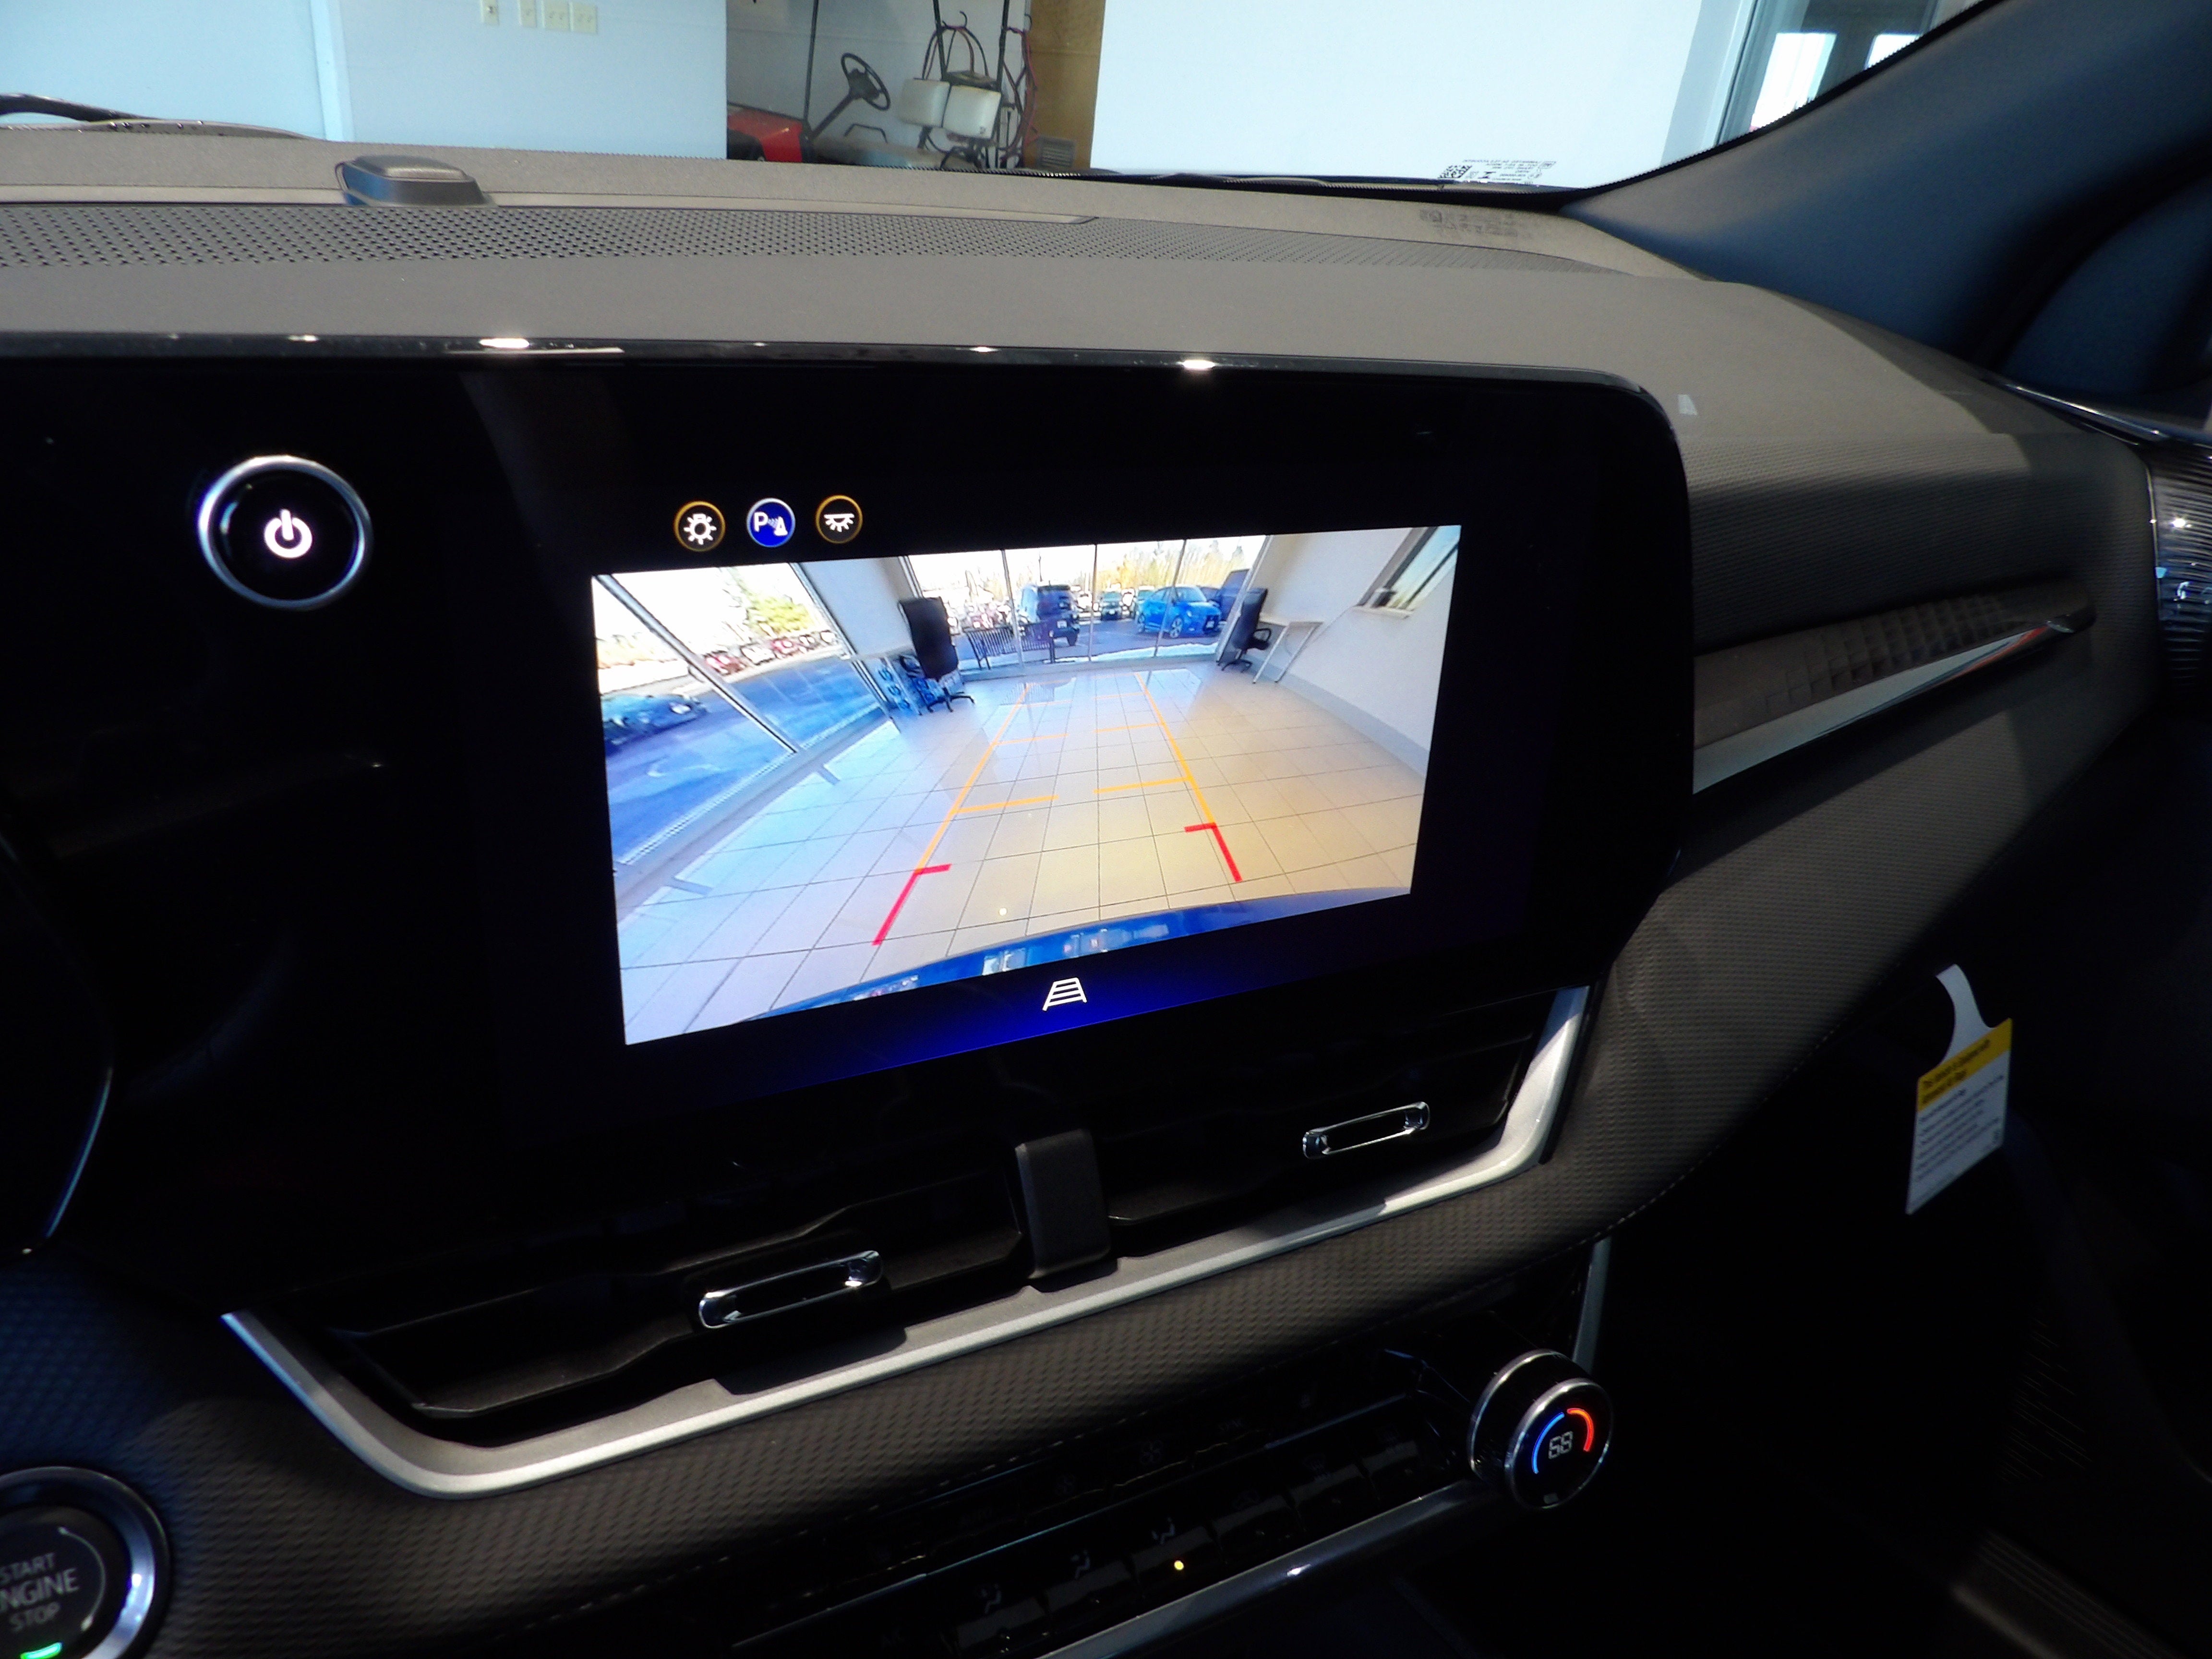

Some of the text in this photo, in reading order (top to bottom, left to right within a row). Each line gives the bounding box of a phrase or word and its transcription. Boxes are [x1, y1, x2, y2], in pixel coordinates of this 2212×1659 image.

[754, 512, 769, 532] P
[0, 1552, 55, 1585] START
[0, 1567, 80, 1613] NGINE
[9, 1601, 61, 1633] STOP
